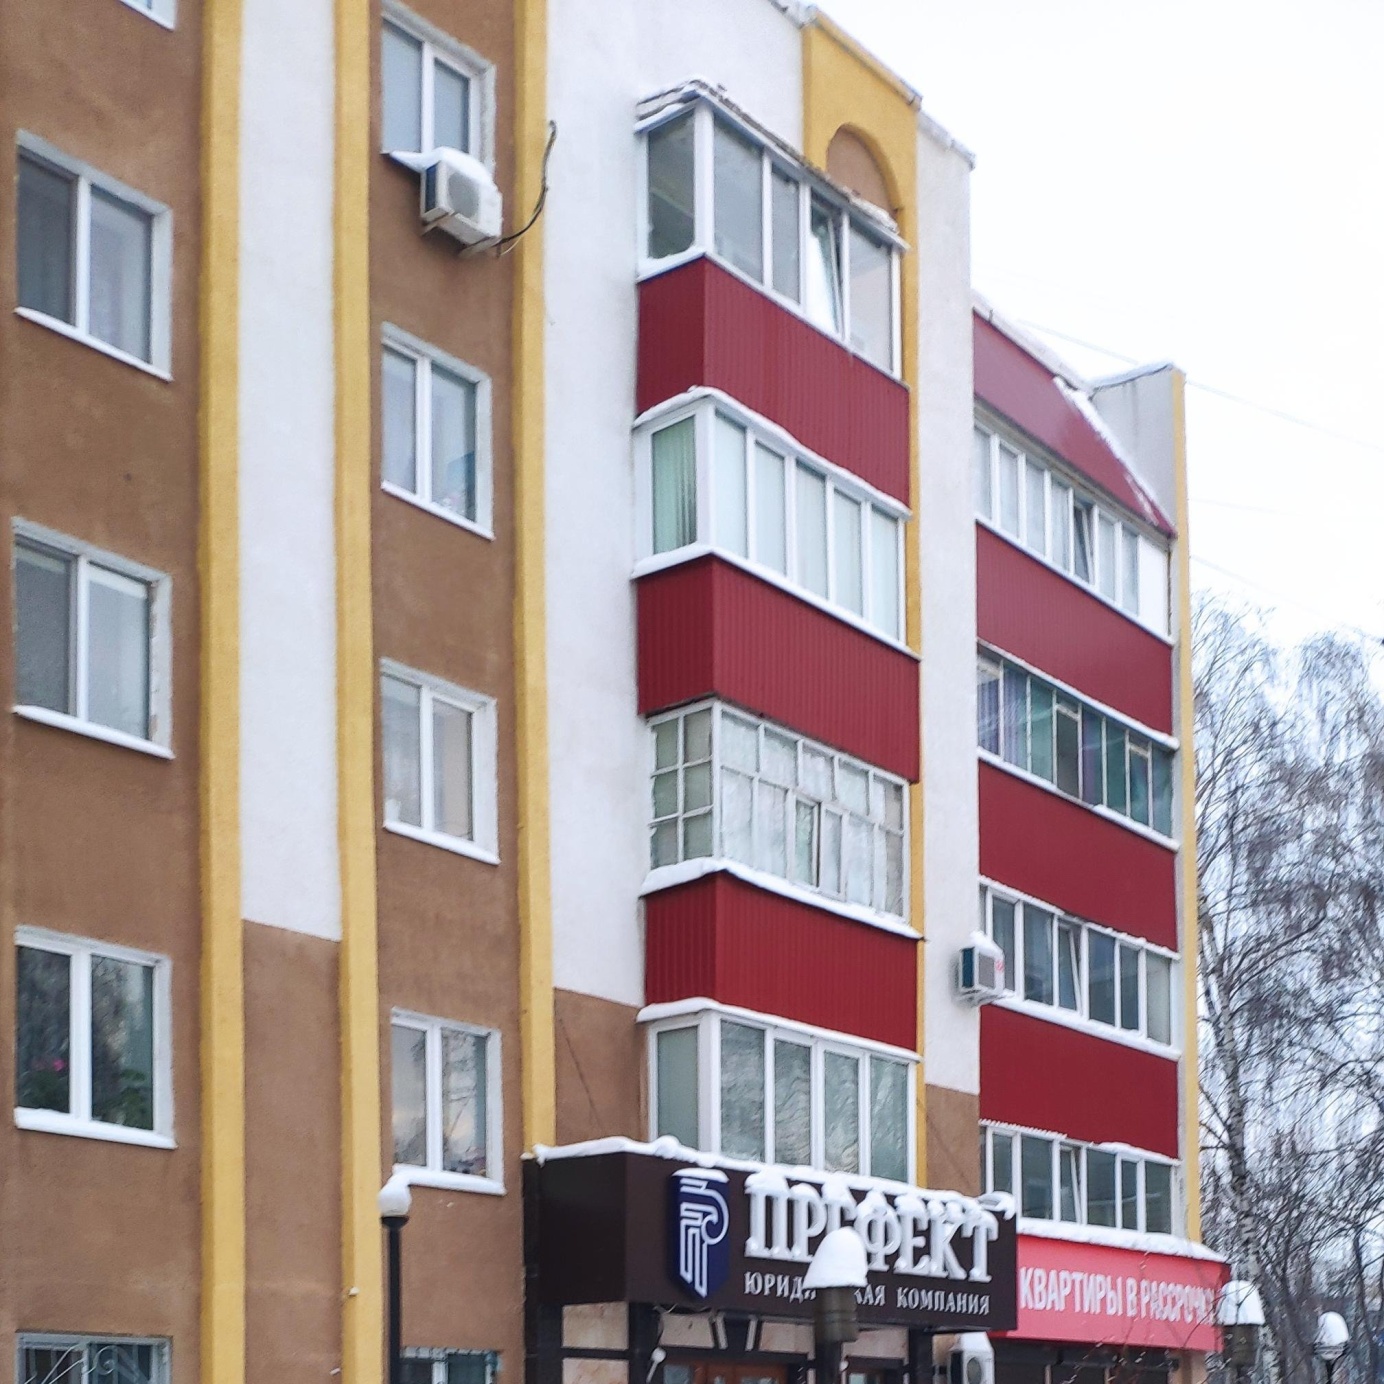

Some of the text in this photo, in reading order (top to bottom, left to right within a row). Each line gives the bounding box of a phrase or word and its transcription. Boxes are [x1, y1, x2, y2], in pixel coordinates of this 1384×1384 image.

[744, 1271, 990, 1316] ЮРИДАЯ КОМПАНИЯ
[1020, 1267, 1123, 1317] КВАРТИРЫ
[1125, 1276, 1138, 1317] В
